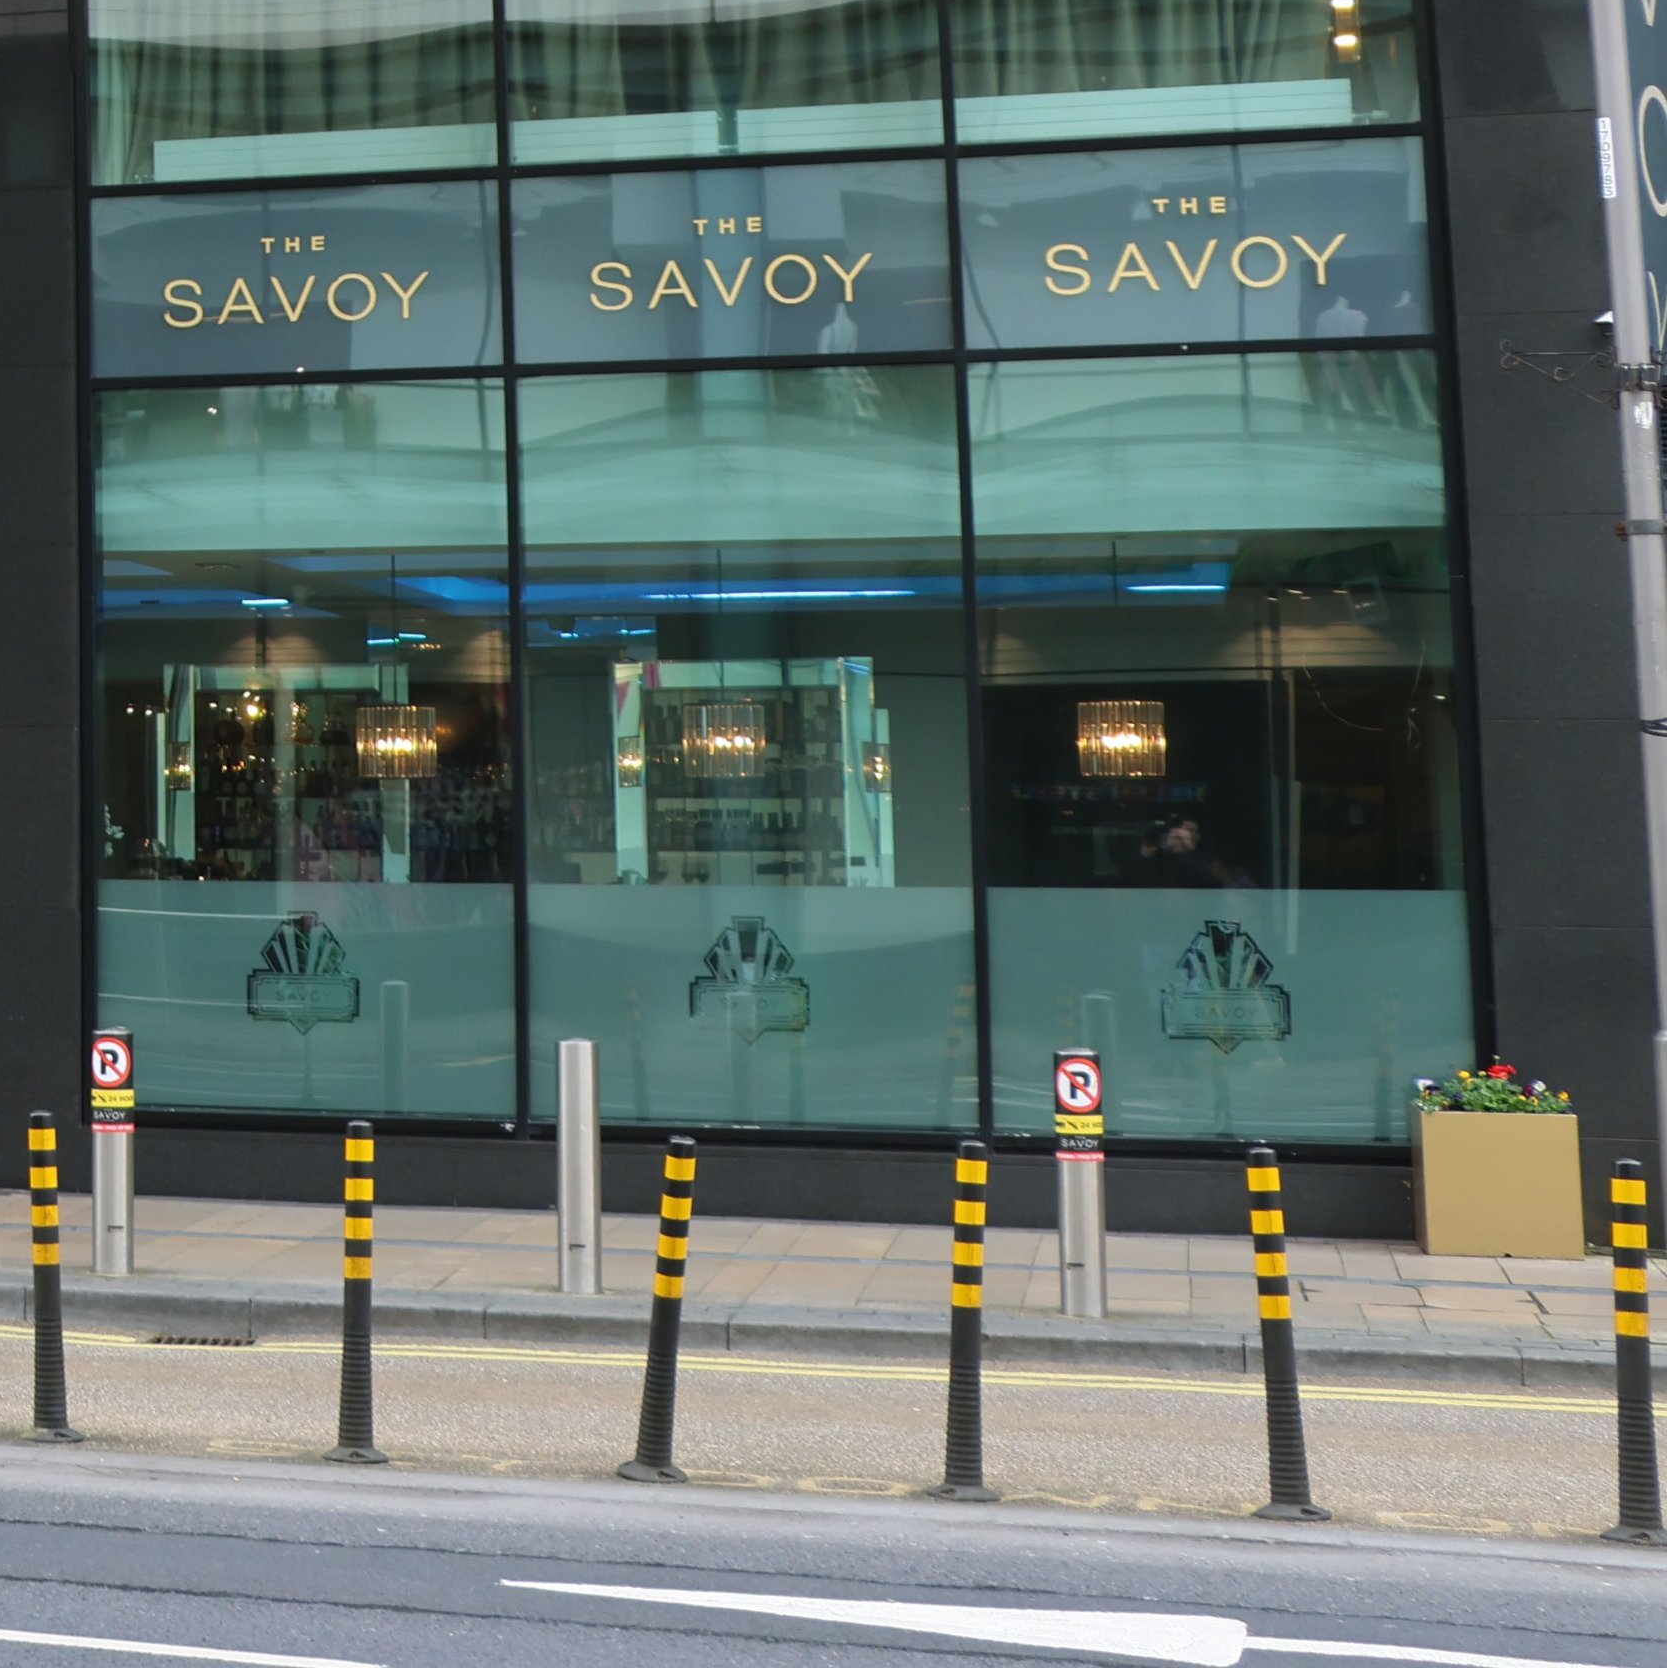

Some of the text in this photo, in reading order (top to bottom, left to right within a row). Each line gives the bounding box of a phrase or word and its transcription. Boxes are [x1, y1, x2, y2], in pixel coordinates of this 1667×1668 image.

[1152, 196, 1227, 215] THE
[692, 216, 764, 235] THE
[260, 235, 327, 254] THE
[1044, 232, 1348, 297] SAVOY
[589, 253, 873, 312] SAVOY
[162, 270, 430, 329] SAVOY
[93, 1111, 126, 1120] SAVOY
[1061, 1139, 1099, 1148] SAVOY
